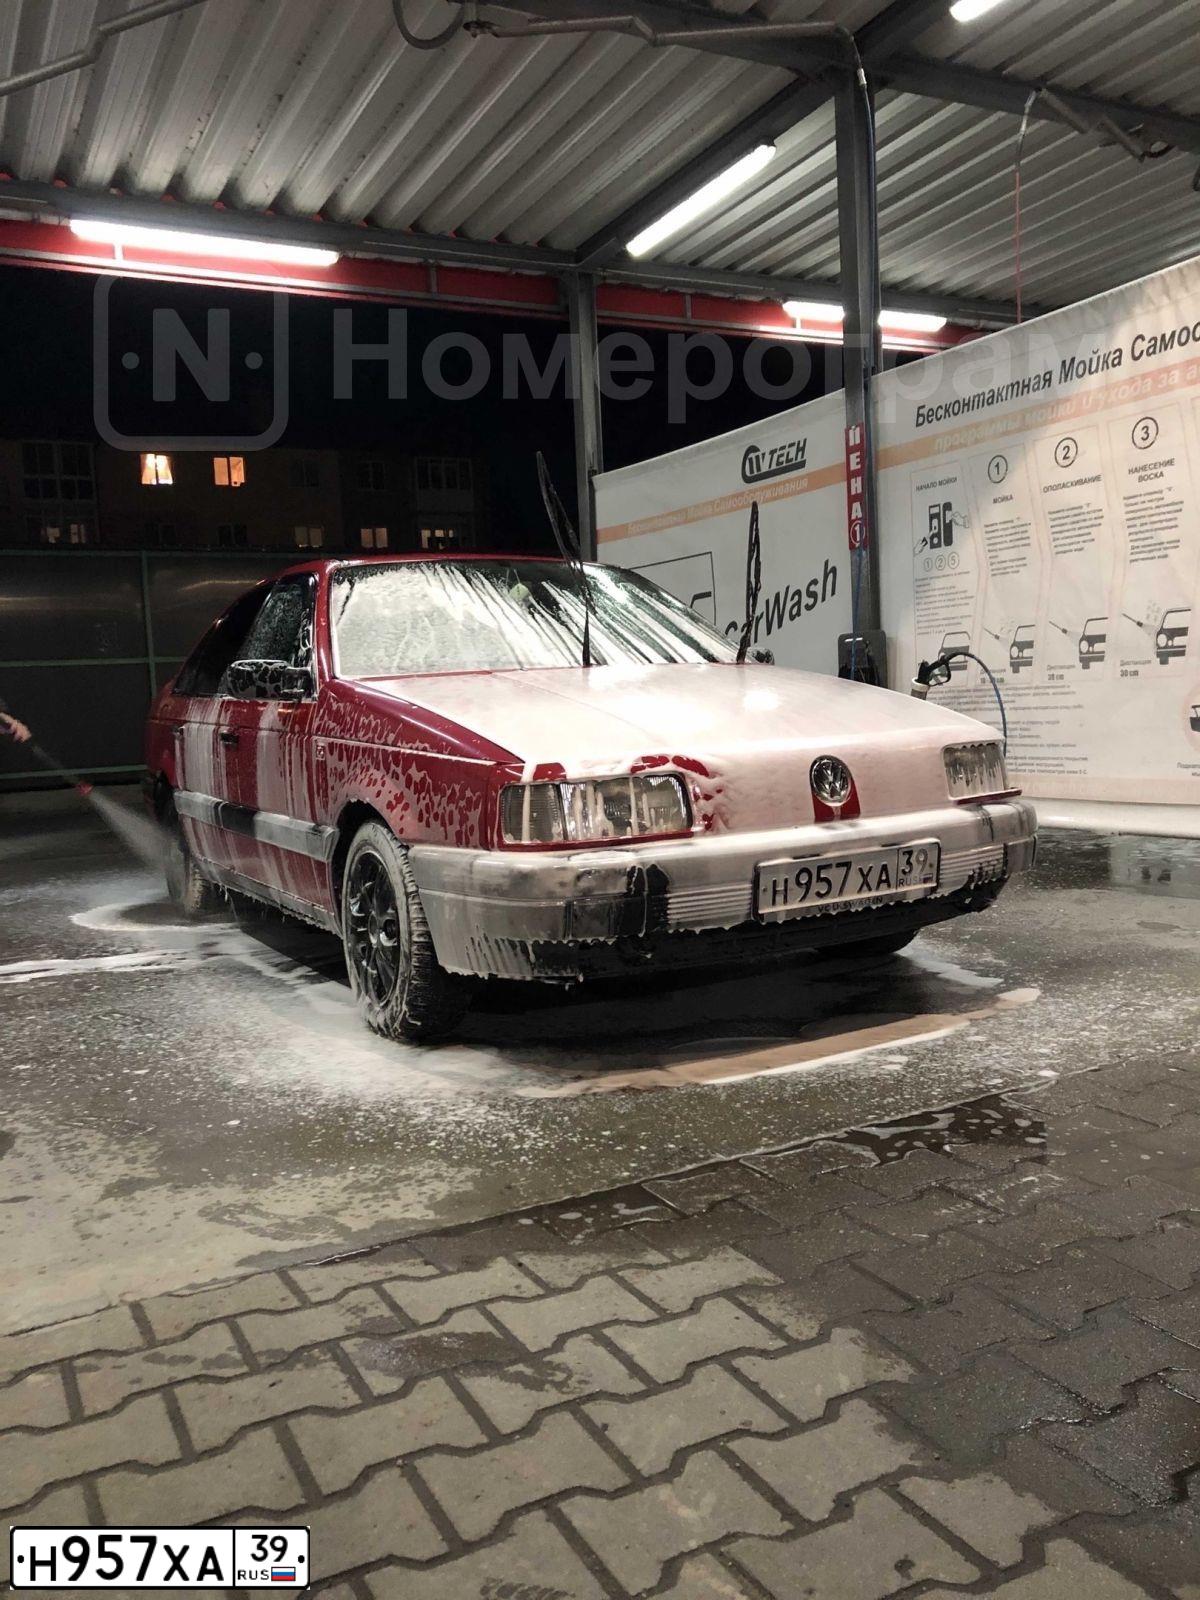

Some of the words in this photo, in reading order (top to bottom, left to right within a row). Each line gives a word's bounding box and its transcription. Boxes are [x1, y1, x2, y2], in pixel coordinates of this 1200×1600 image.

[914, 369, 1053, 428] Бесконтактная
[1057, 347, 1123, 386] Мойка
[1157, 369, 1180, 389] за
[767, 438, 808, 470] TECH
[848, 426, 864, 520] ПЕНА
[1128, 458, 1175, 475] НАНЕСЕНИЕ
[915, 482, 937, 492] НАЧАЛО
[938, 476, 958, 487] МОЙКИ
[1042, 473, 1103, 494] ОПОЛАСКИВАНИЕ
[1137, 471, 1165, 483] ВОСКА
[992, 494, 1014, 504] МОЙКА
[901, 848, 930, 876] 39
